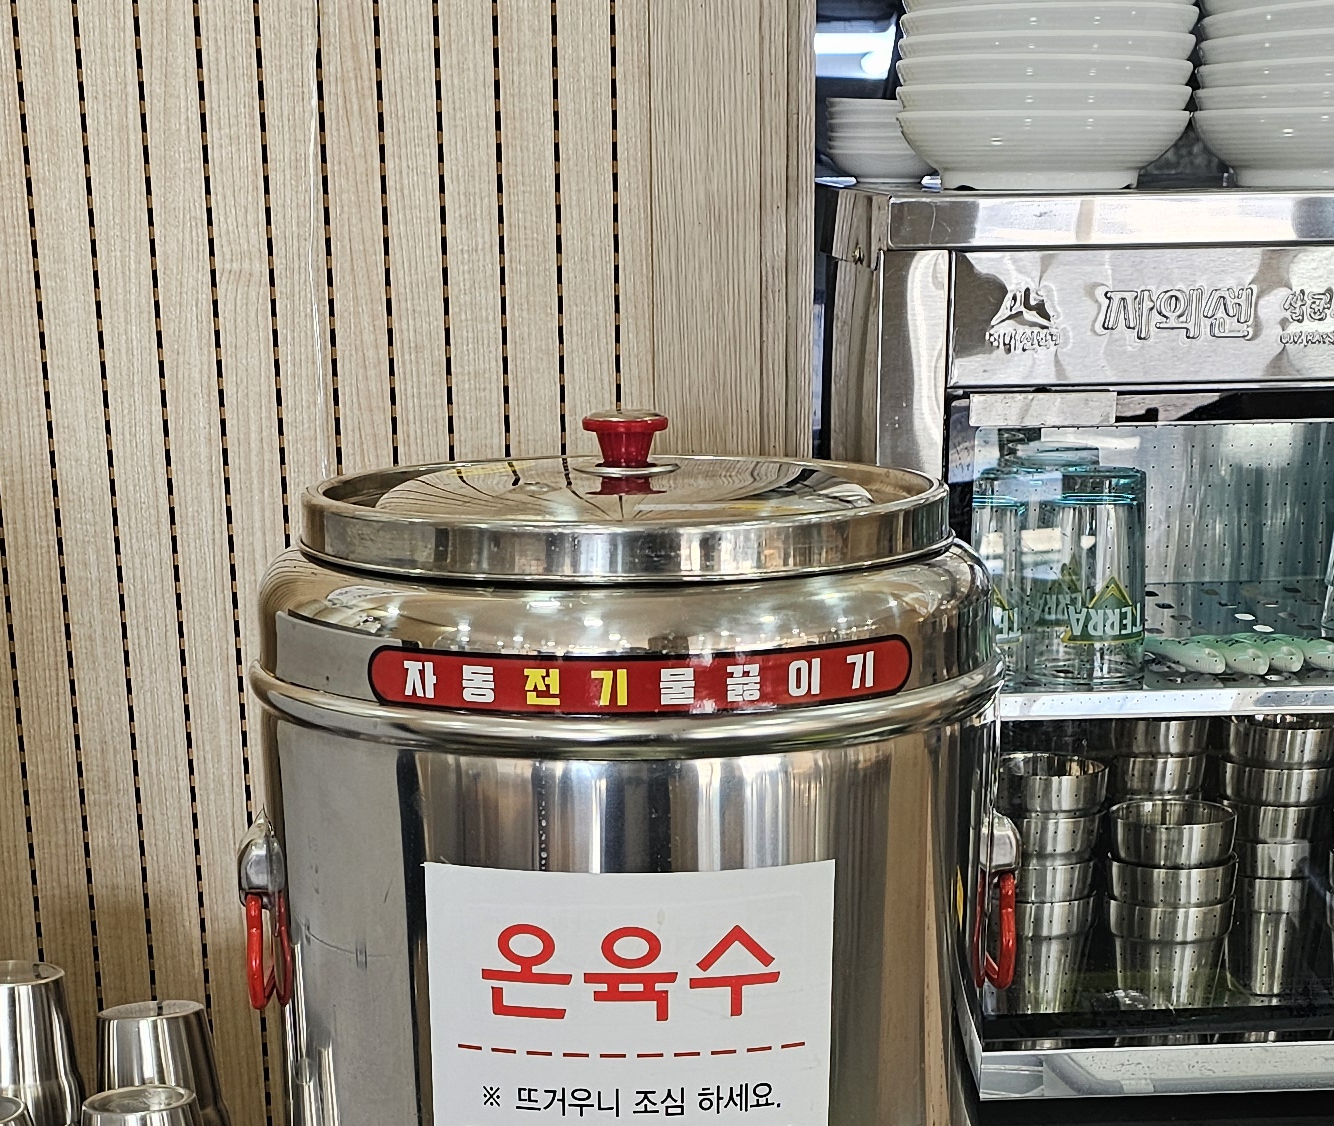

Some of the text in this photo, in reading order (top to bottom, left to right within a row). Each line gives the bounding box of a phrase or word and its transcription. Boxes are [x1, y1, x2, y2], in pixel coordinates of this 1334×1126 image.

[1102, 287, 1254, 340] 자외선
[1067, 601, 1143, 637] TERRA
[481, 924, 781, 1022] 온육수
[515, 1086, 621, 1118] 뜨거우니
[632, 1087, 686, 1117] 조심
[697, 1081, 782, 1115] 하세요.
